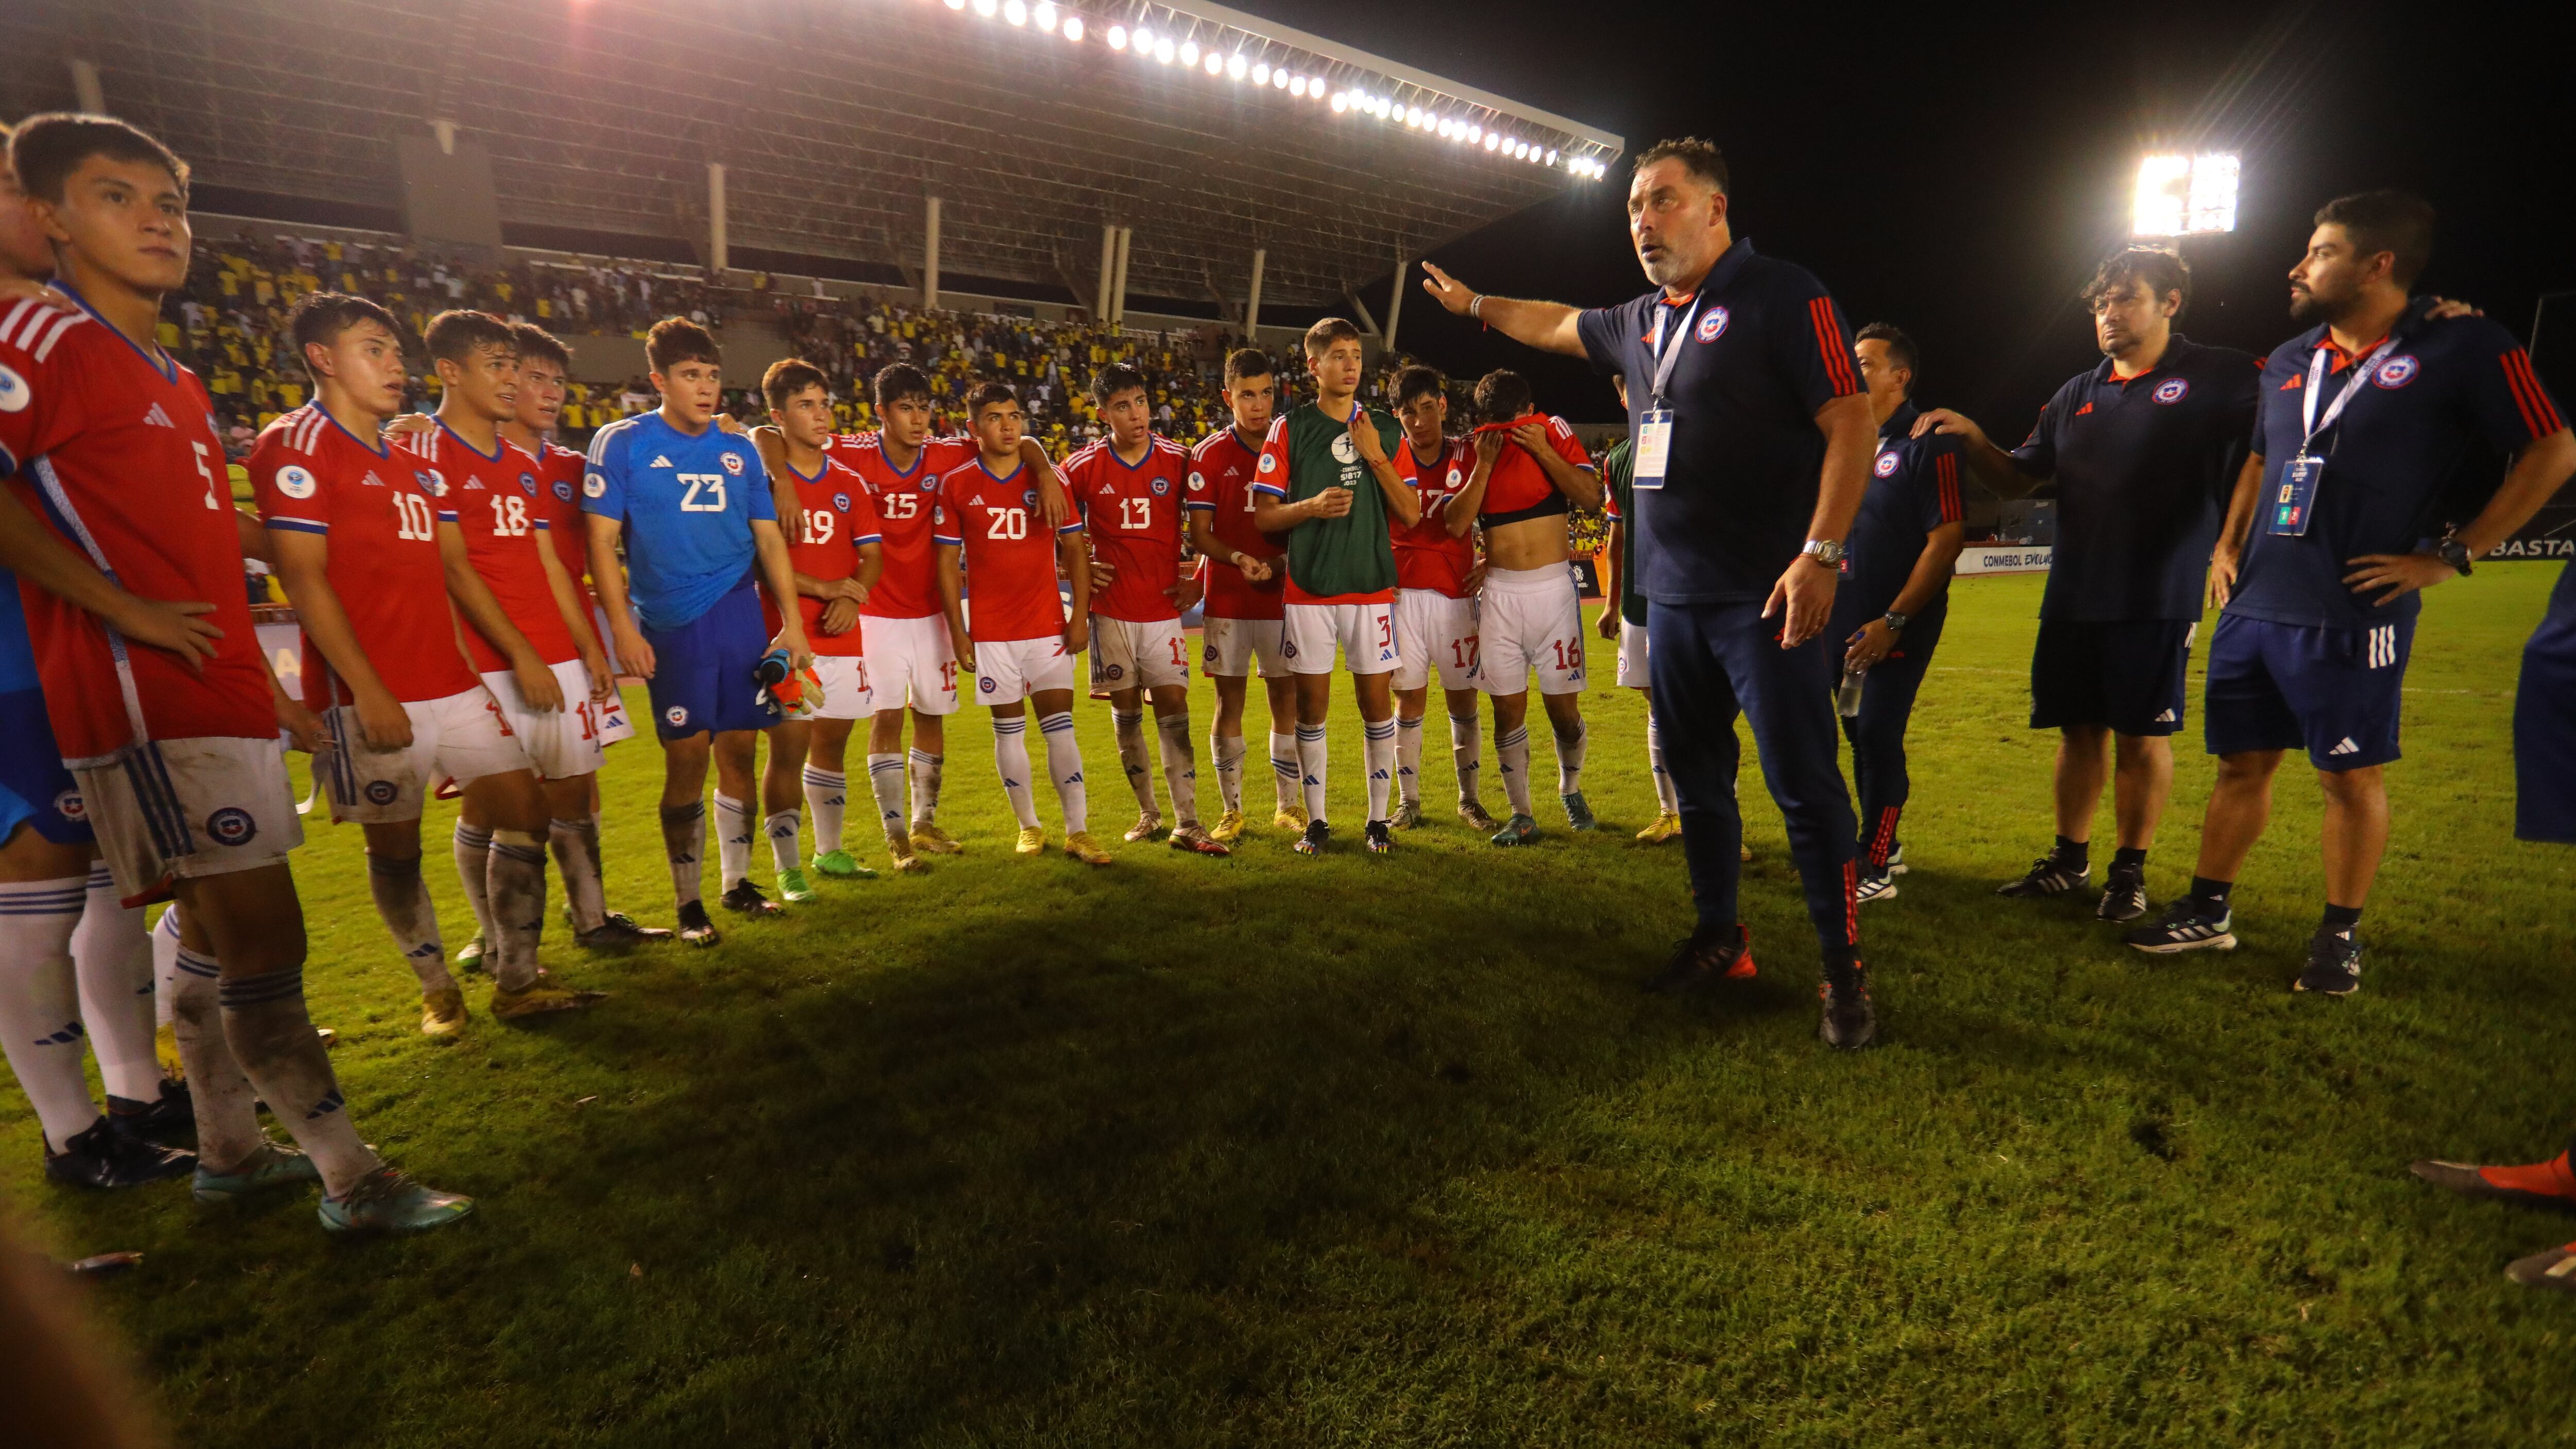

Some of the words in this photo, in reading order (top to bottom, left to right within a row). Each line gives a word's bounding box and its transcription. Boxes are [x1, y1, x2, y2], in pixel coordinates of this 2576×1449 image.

[191, 440, 220, 510] 5
[676, 473, 727, 512] 23
[884, 493, 918, 519] 15
[392, 490, 432, 541] 10
[489, 494, 529, 536] 18
[802, 509, 834, 544] 19
[987, 507, 1026, 540] 20
[1118, 498, 1150, 529] 13
[1984, 555, 2022, 567] CONMEBOL
[1377, 615, 1391, 648] 3
[1451, 635, 1479, 668] 17
[1553, 637, 1581, 670] 16
